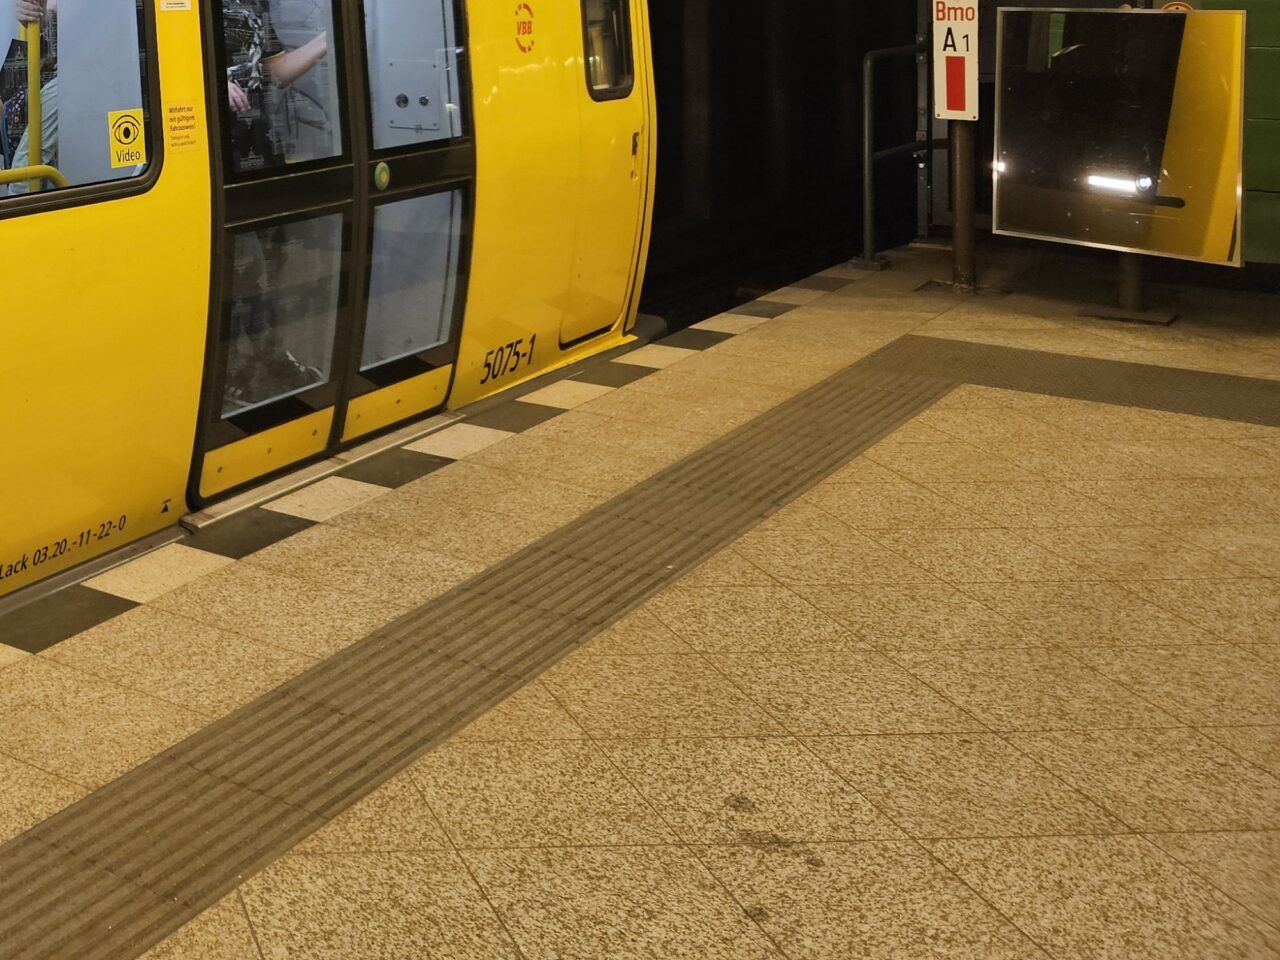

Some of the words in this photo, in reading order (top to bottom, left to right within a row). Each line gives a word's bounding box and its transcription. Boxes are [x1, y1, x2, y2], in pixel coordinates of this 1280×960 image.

[935, 0, 975, 22] Bmo
[516, 20, 532, 36] VBB
[115, 149, 140, 163] Video
[479, 333, 537, 385] 5075-1
